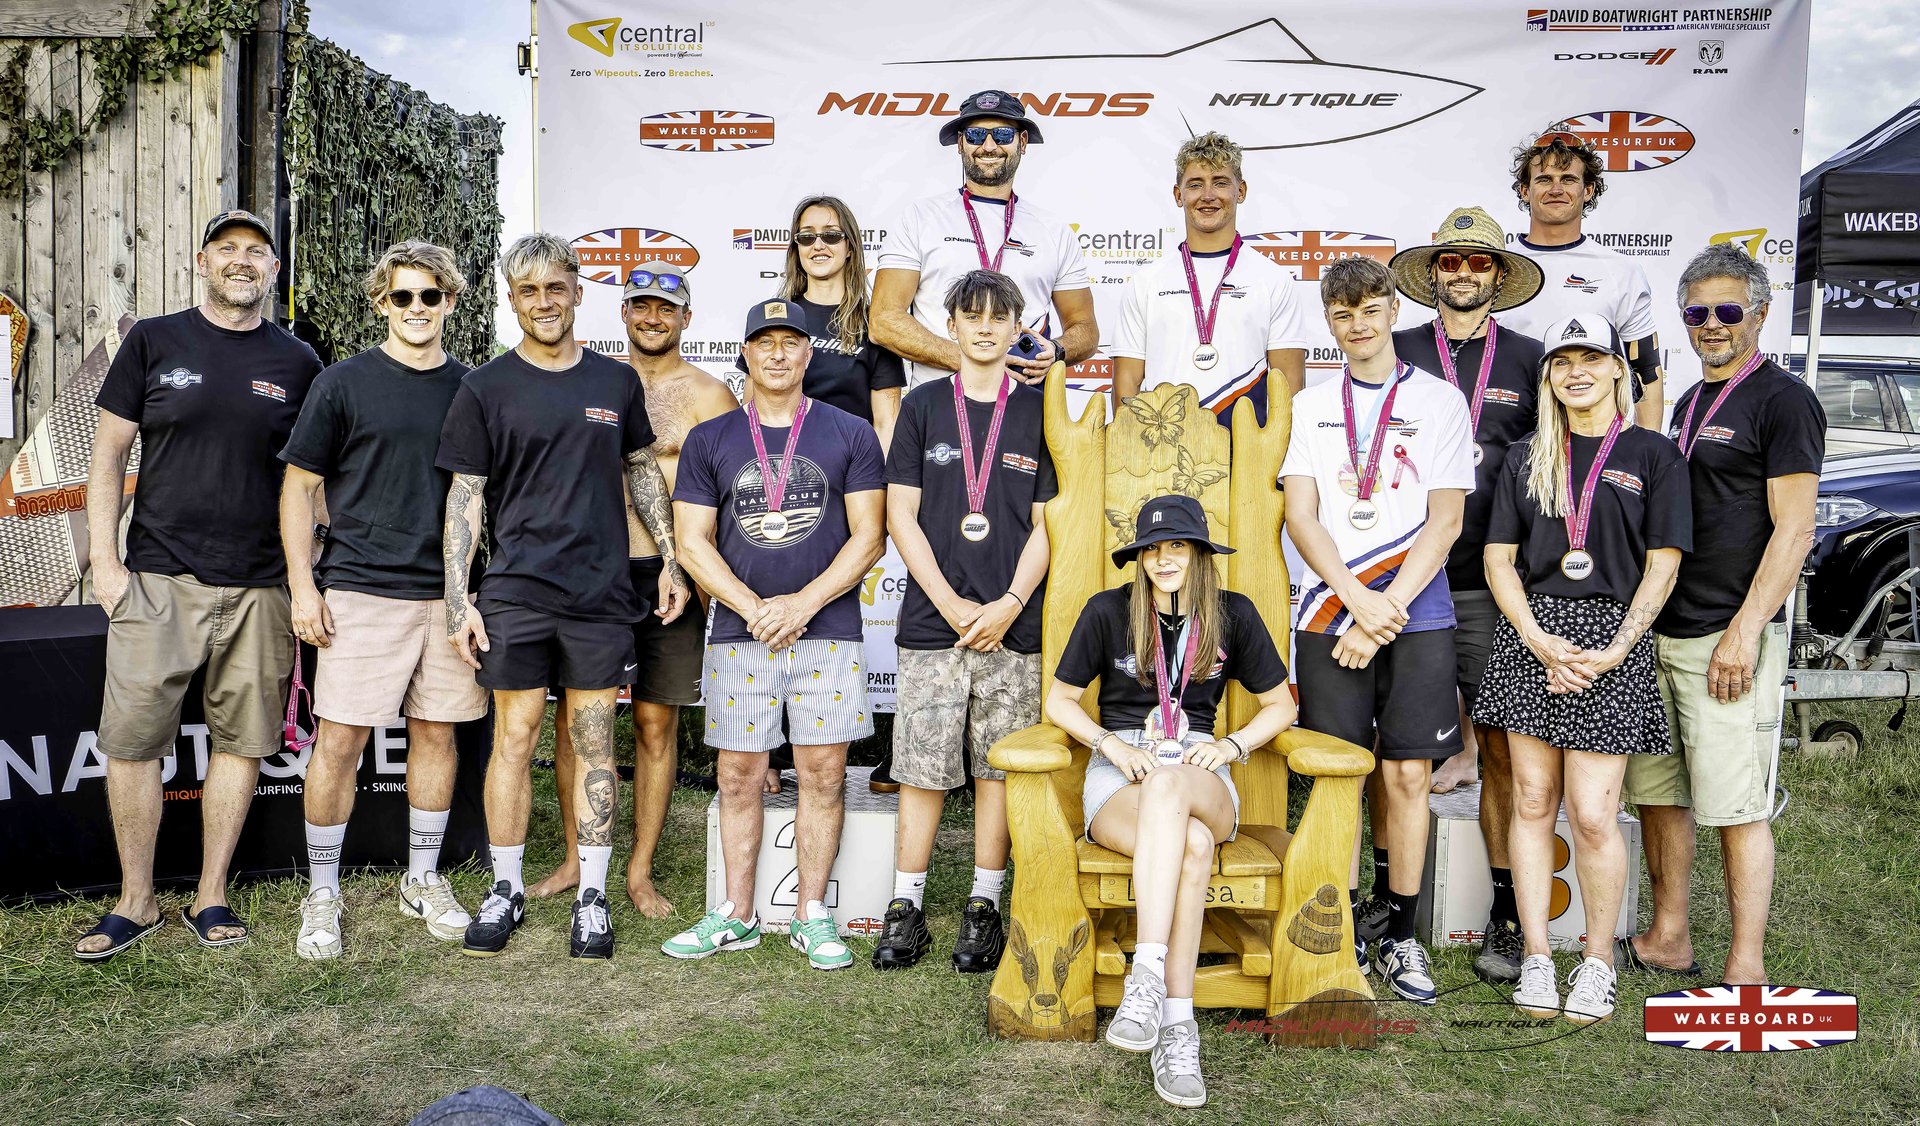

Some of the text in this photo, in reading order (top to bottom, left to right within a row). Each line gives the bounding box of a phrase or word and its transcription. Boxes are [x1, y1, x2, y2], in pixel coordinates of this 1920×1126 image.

[1550, 8, 1772, 23] DAVID BOATWRIGHT PARTNERSHIP
[1736, 23, 1770, 31] SPECIALIST
[620, 22, 703, 43] central
[634, 43, 703, 51] SOLUTIONS
[1554, 52, 1657, 61] DODGE
[570, 69, 714, 78] Zero Wipeouts. Zero Breaches.
[817, 91, 1154, 117] MIDLNDS
[1208, 93, 1400, 109] NAUTIQUE
[659, 127, 747, 136] WAKEBOARD
[1581, 137, 1676, 146] KESURF UK
[1844, 212, 1920, 232] WAKEB
[754, 229, 791, 242] DAVID
[1078, 228, 1162, 250] central
[733, 242, 748, 250] DBP
[582, 253, 682, 262] WAKESURF UK
[1261, 251, 1360, 260] AKEBOARD
[1101, 276, 1123, 284] Zero
[1560, 333, 1588, 341] PICTURE
[589, 340, 624, 353] DAVID
[14, 485, 87, 520] boardwi
[740, 492, 818, 506] NAUIQUE
[310, 850, 340, 859] STANCE
